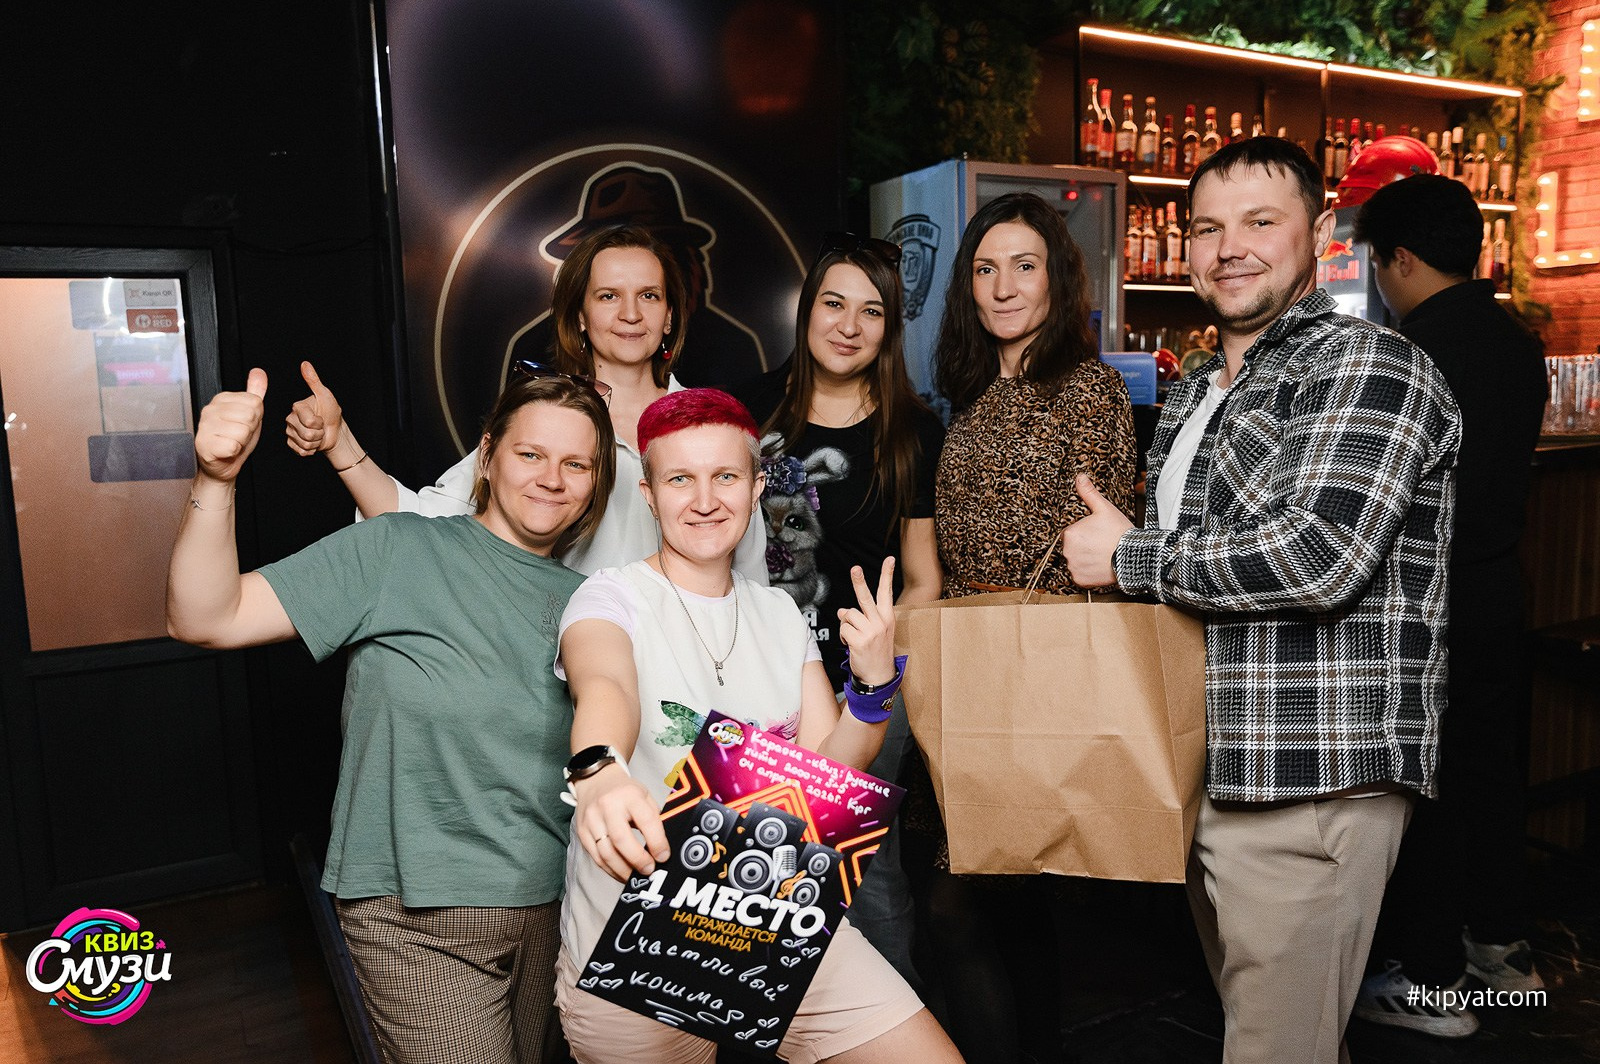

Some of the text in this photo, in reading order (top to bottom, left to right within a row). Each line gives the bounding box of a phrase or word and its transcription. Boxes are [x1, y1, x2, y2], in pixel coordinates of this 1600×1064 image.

[1327, 260, 1360, 282] Bull
[639, 869, 826, 938] 1 МЕСТО
[671, 909, 779, 945] НАГРАЖДАЕТСЯ
[684, 926, 752, 952] КОМАНДА
